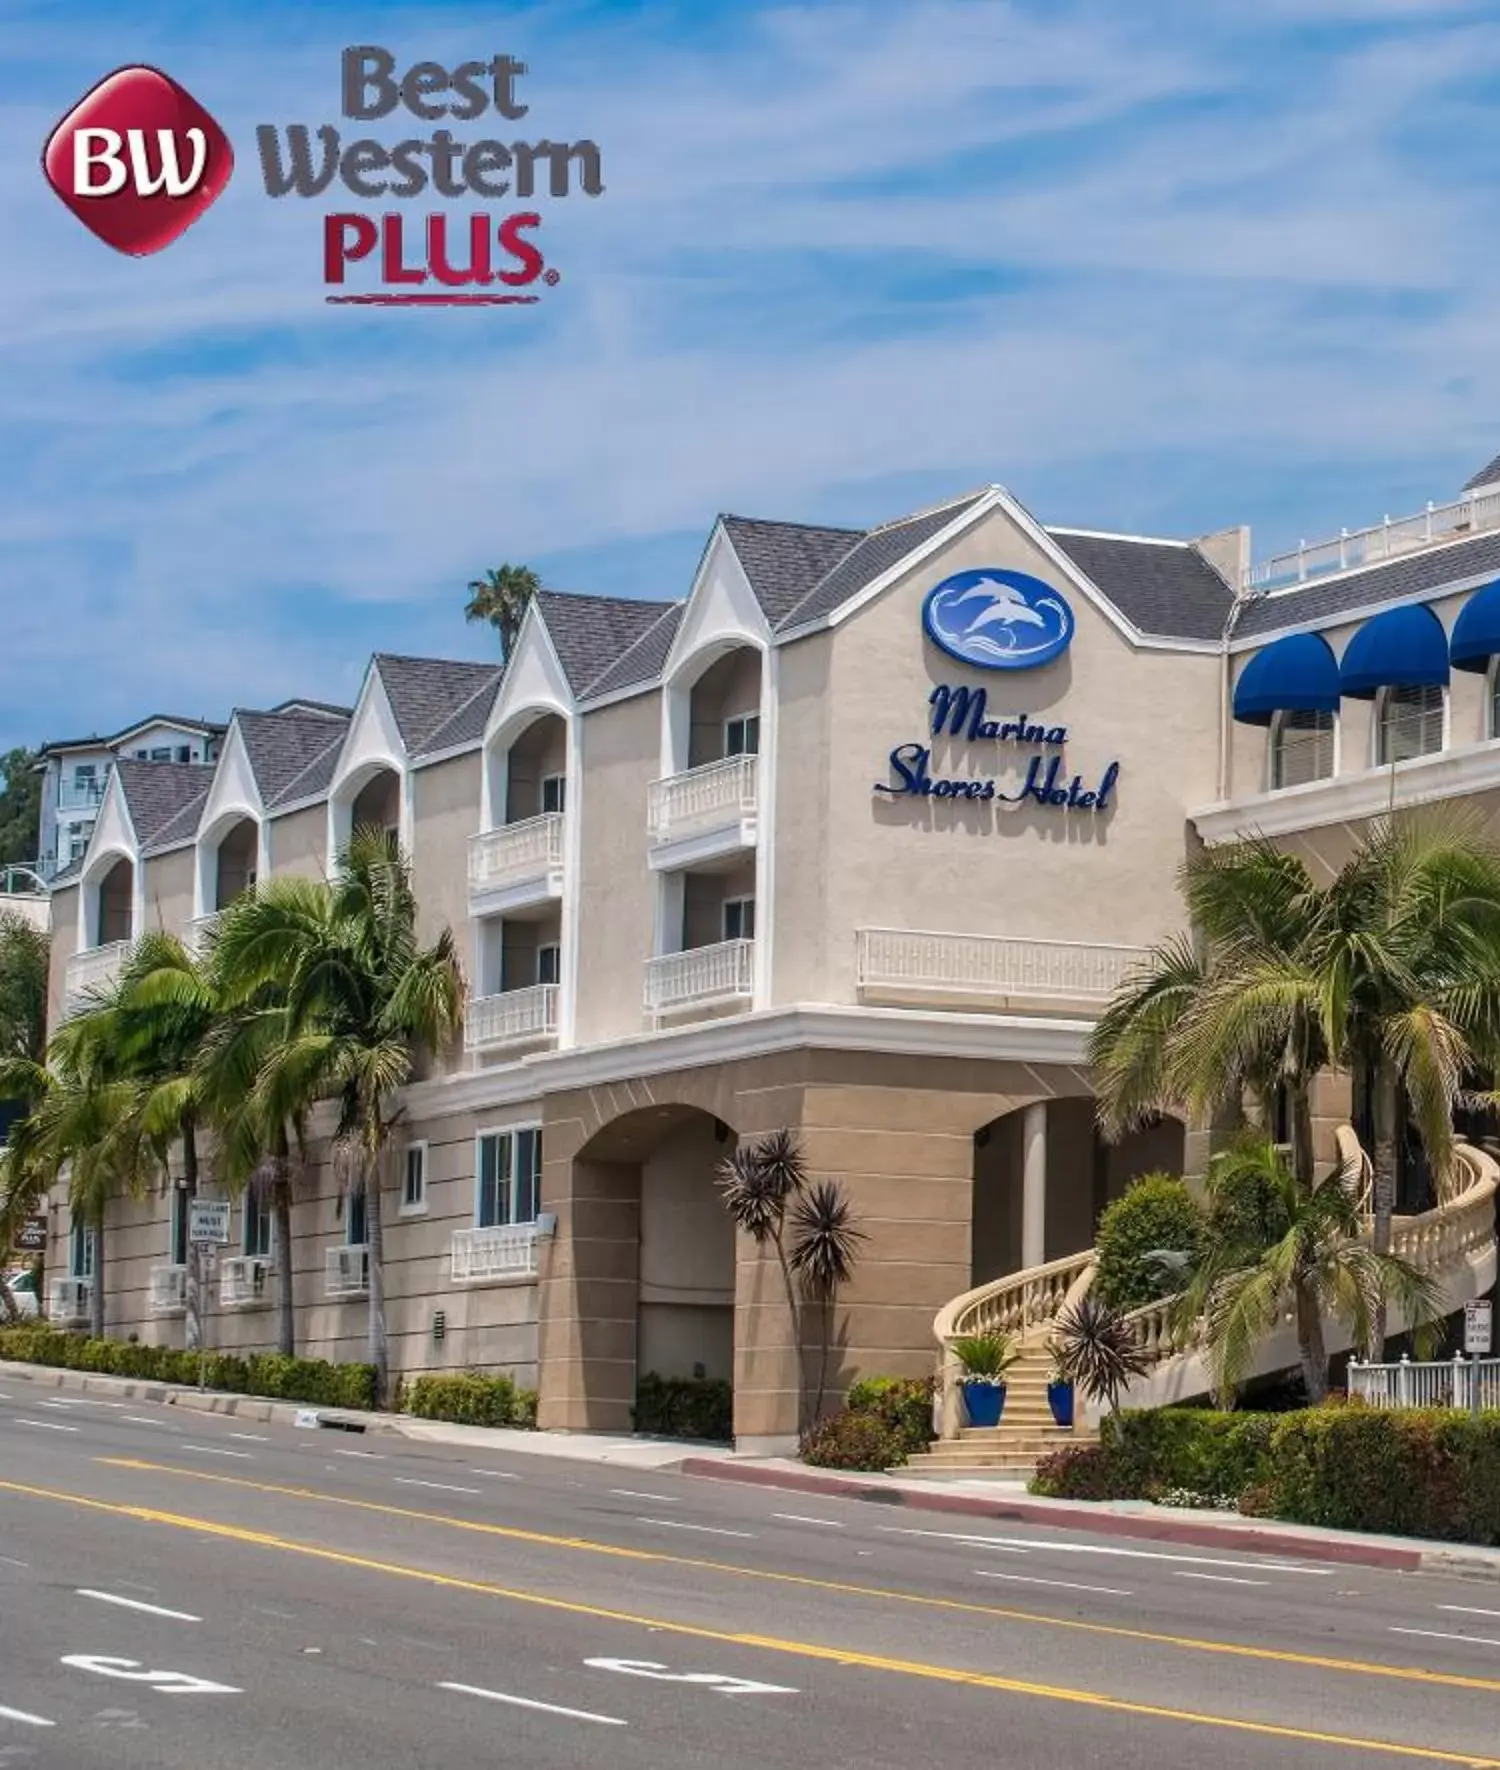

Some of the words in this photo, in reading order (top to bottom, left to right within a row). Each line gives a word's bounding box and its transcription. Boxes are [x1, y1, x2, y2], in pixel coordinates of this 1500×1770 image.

[929, 684, 1068, 743] Marina
[874, 743, 994, 800] Shores
[997, 755, 1119, 809] Hotel
